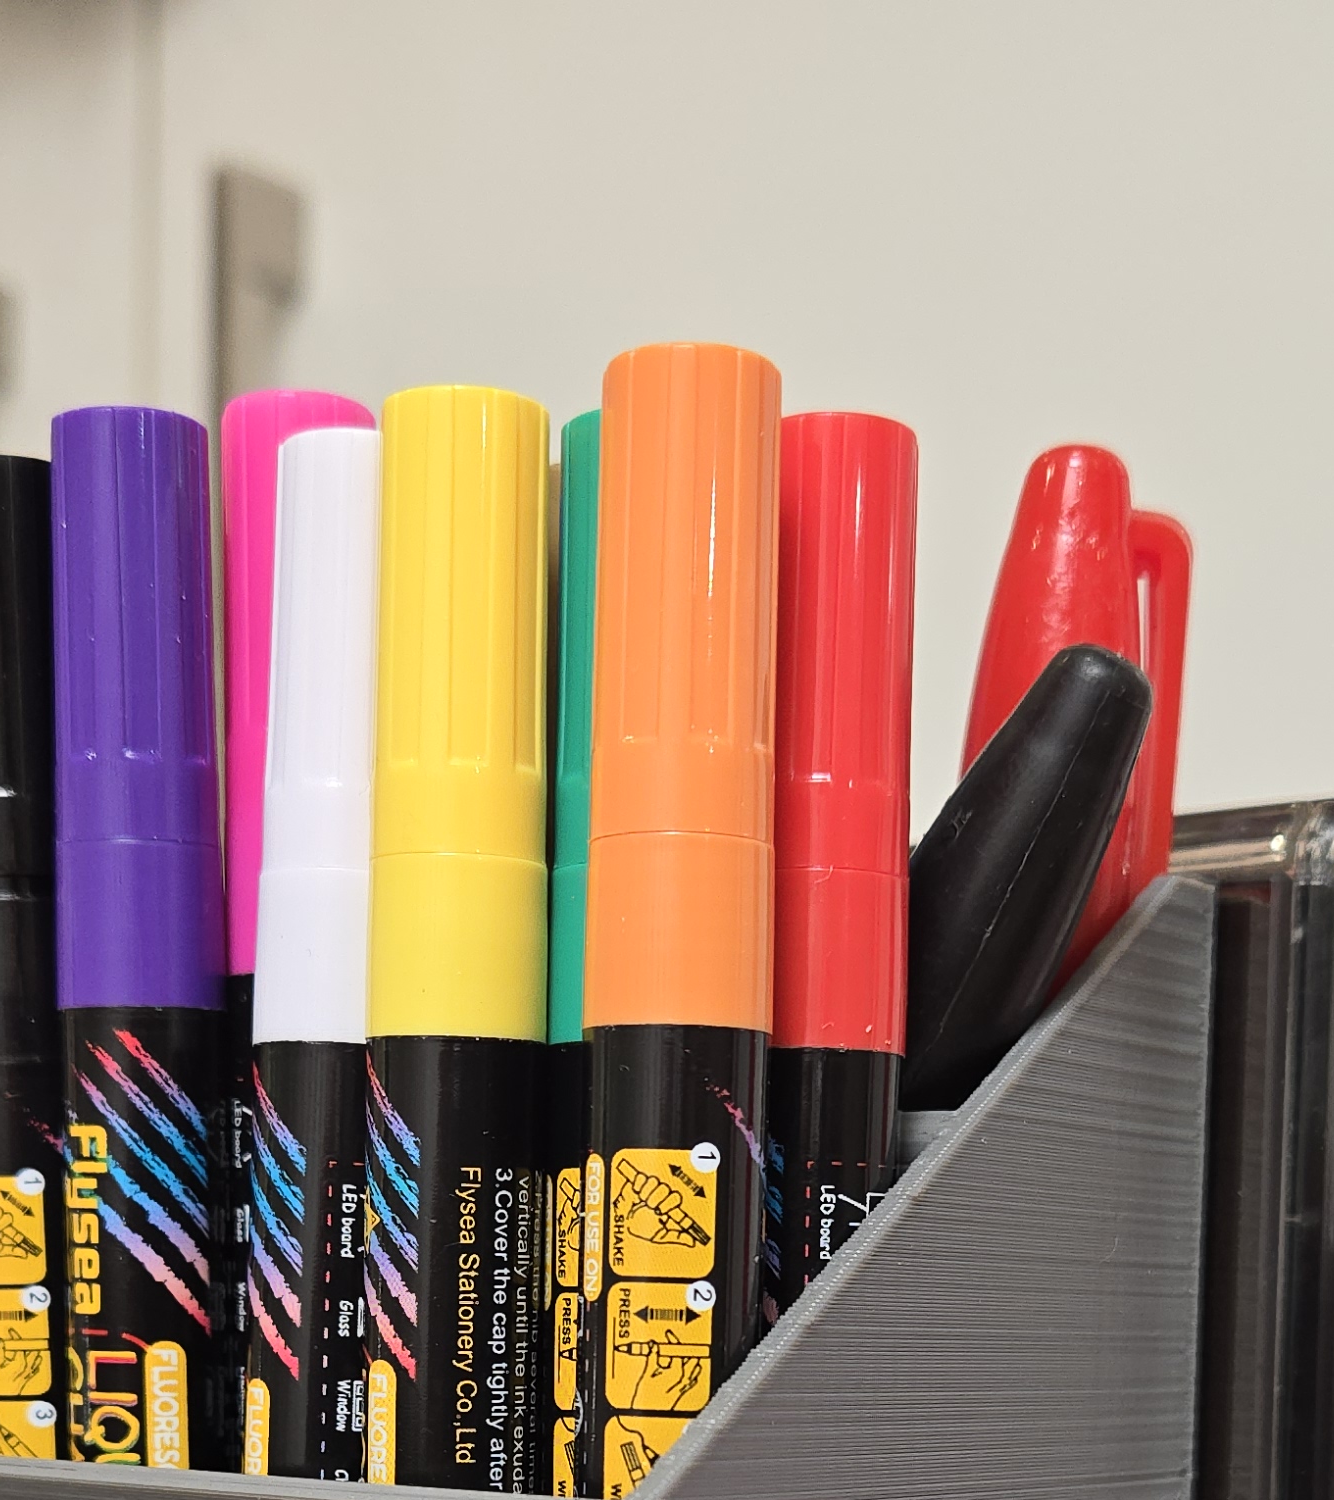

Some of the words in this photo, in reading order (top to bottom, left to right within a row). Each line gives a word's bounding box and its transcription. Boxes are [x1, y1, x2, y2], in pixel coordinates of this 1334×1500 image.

[233, 1100, 243, 1128] LED
[233, 1130, 244, 1169] board
[698, 1151, 715, 1163] 1
[340, 1184, 357, 1214] LED
[587, 1161, 601, 1205] FOR
[819, 1184, 836, 1215] LED
[66, 1124, 109, 1316] Flysea
[455, 1166, 482, 1245] Flysea
[494, 1167, 513, 1262] 3.Cover
[339, 1217, 357, 1258] board
[513, 1176, 534, 1279] vertically
[586, 1210, 600, 1252] USE
[612, 1214, 626, 1267] SHAKE
[819, 1218, 834, 1260] board
[557, 1230, 568, 1278] SHAKE
[29, 1291, 48, 1304] 2
[493, 1267, 511, 1305] the
[693, 1287, 713, 1303] 2
[337, 1299, 354, 1338] Glass
[452, 1253, 481, 1373] Stationery
[514, 1286, 531, 1334] until
[561, 1297, 572, 1345] PRESS
[618, 1287, 632, 1340] PRESS
[486, 1312, 507, 1355] cap
[514, 1341, 529, 1377] the
[35, 1408, 53, 1421] 3
[334, 1379, 352, 1433] Window
[485, 1362, 509, 1431] tightly
[513, 1385, 528, 1419] ink
[452, 1380, 479, 1464] Co.,Ltd
[488, 1437, 508, 1492] after
